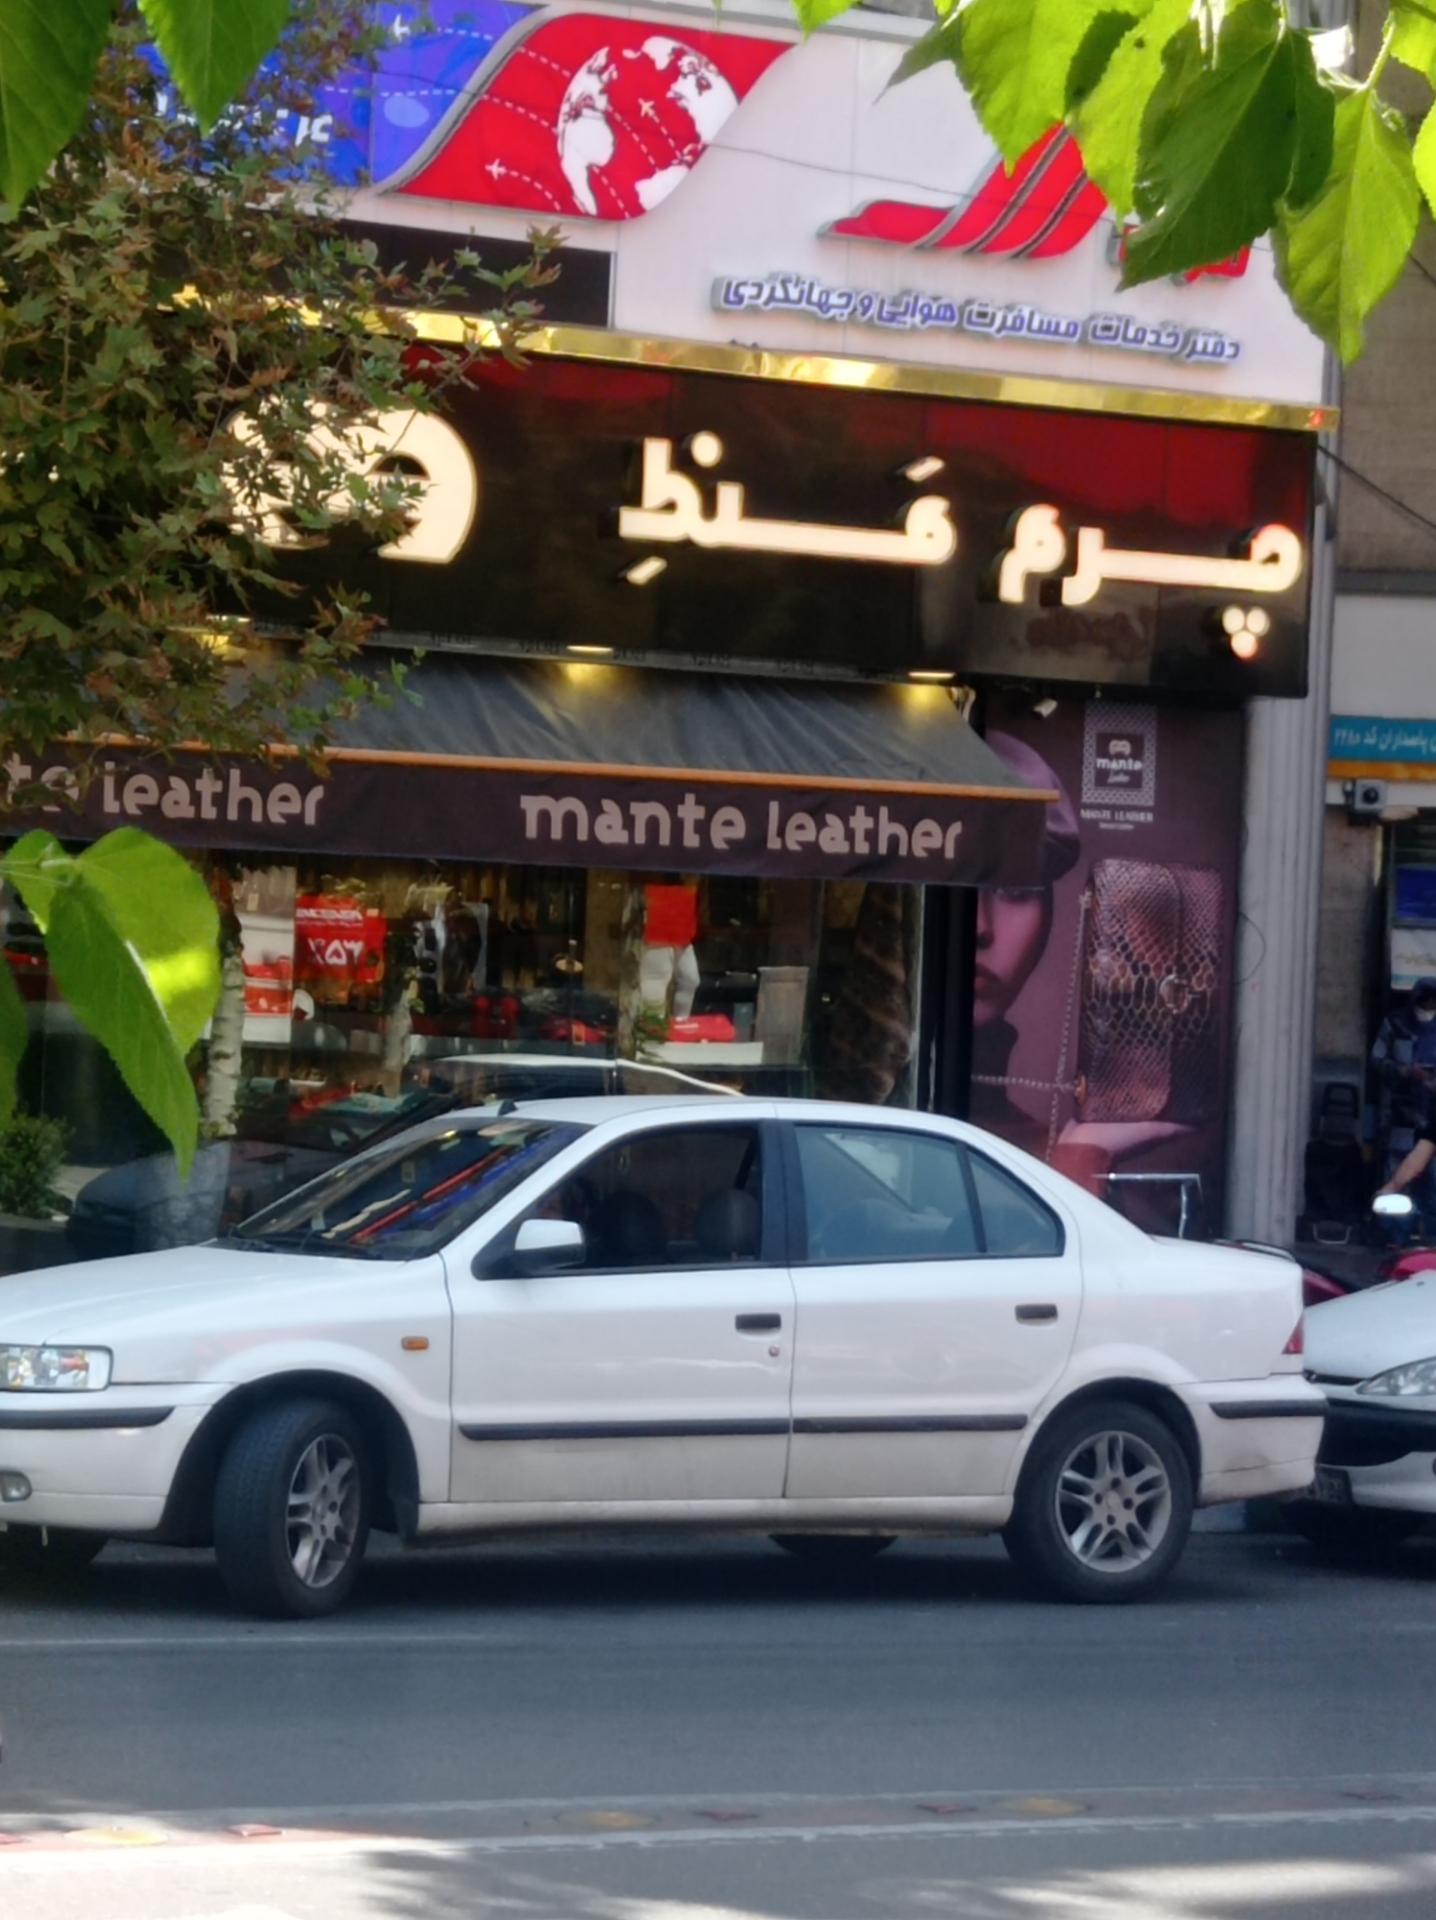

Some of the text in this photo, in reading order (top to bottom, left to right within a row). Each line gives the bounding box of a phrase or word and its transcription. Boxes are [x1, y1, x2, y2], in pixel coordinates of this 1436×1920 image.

[722, 275, 855, 317] جهانگردی
[876, 296, 958, 328] هوایی
[963, 303, 1081, 342] مسافرت
[1089, 313, 1181, 355] خدمات
[1184, 328, 1241, 364] دفتر
[999, 503, 1301, 661] چرم
[1096, 757, 1143, 771] mante
[102, 761, 324, 826] leather
[520, 793, 963, 860] mante leather
